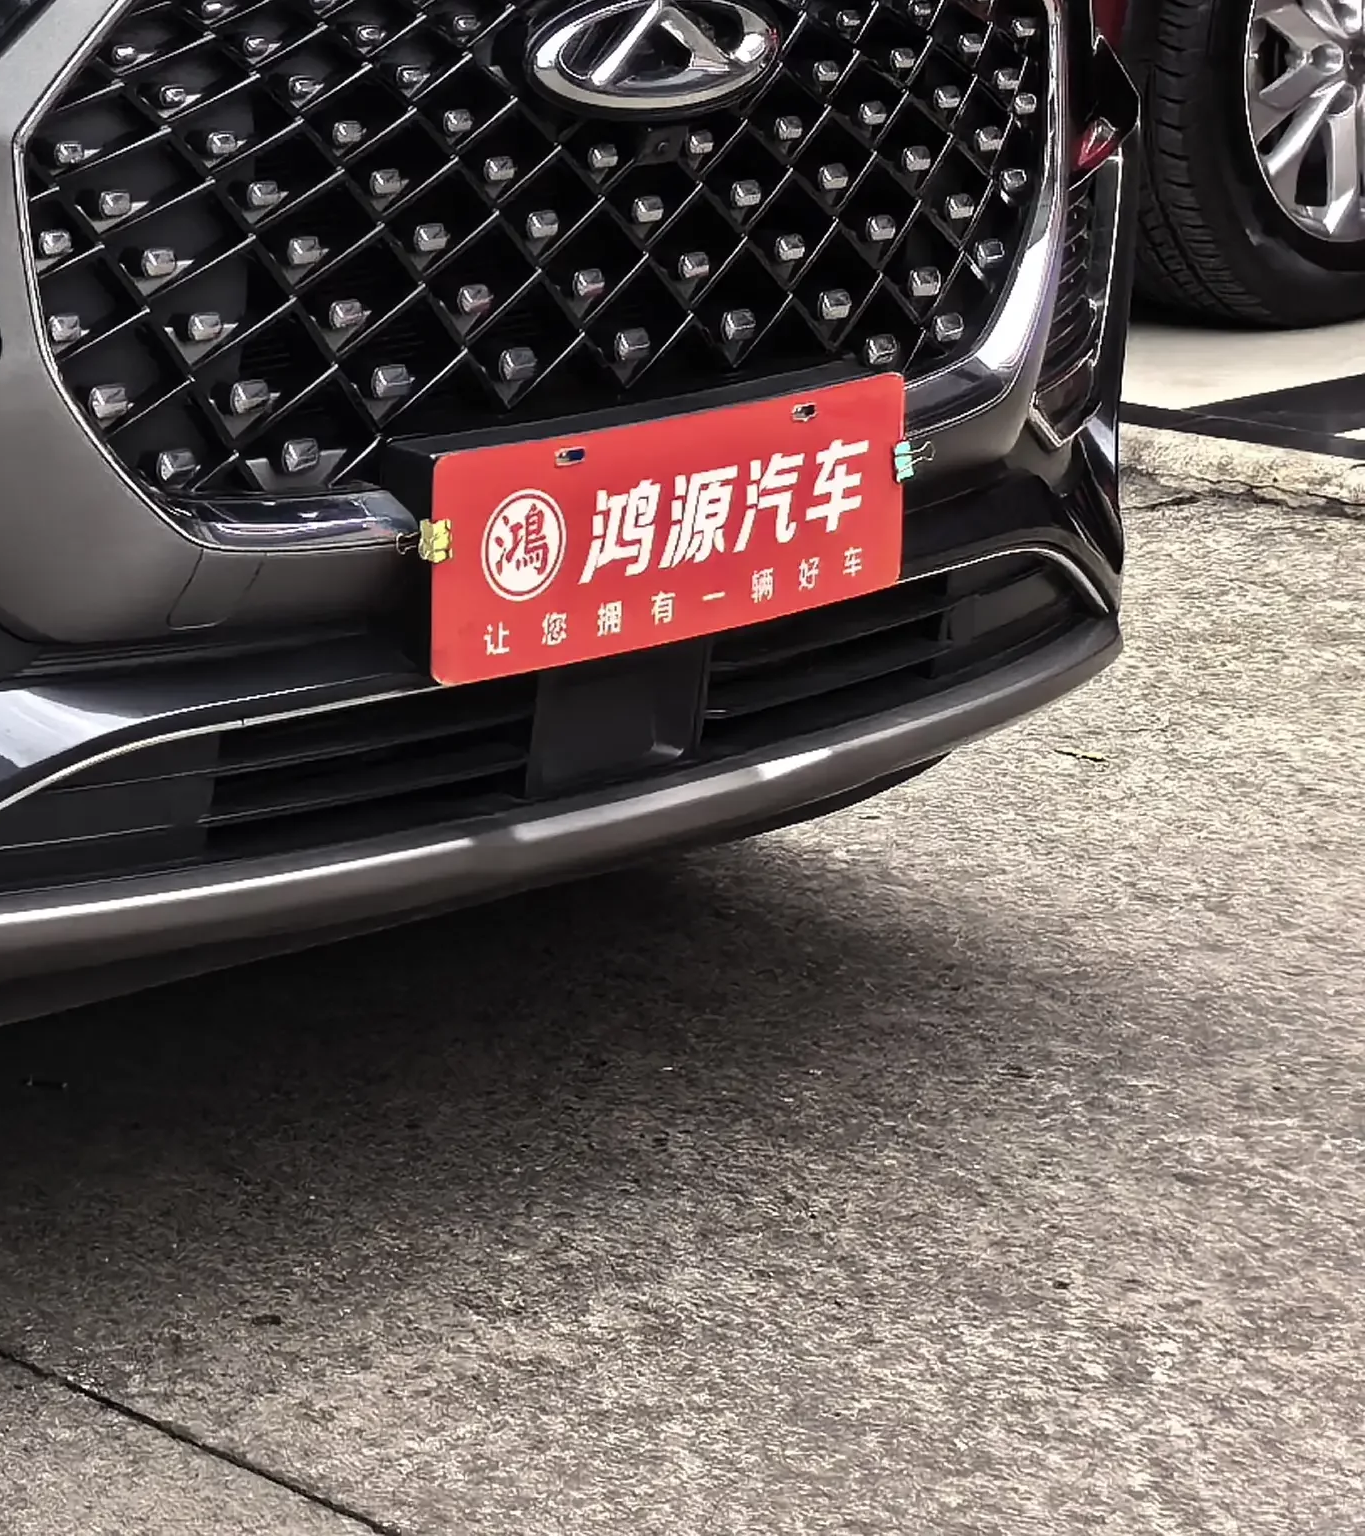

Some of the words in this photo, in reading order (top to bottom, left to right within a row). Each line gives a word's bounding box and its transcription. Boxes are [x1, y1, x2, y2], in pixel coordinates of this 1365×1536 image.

[577, 439, 869, 584] 鸿源汽车
[483, 546, 863, 656] 让您拥有一辆好车
